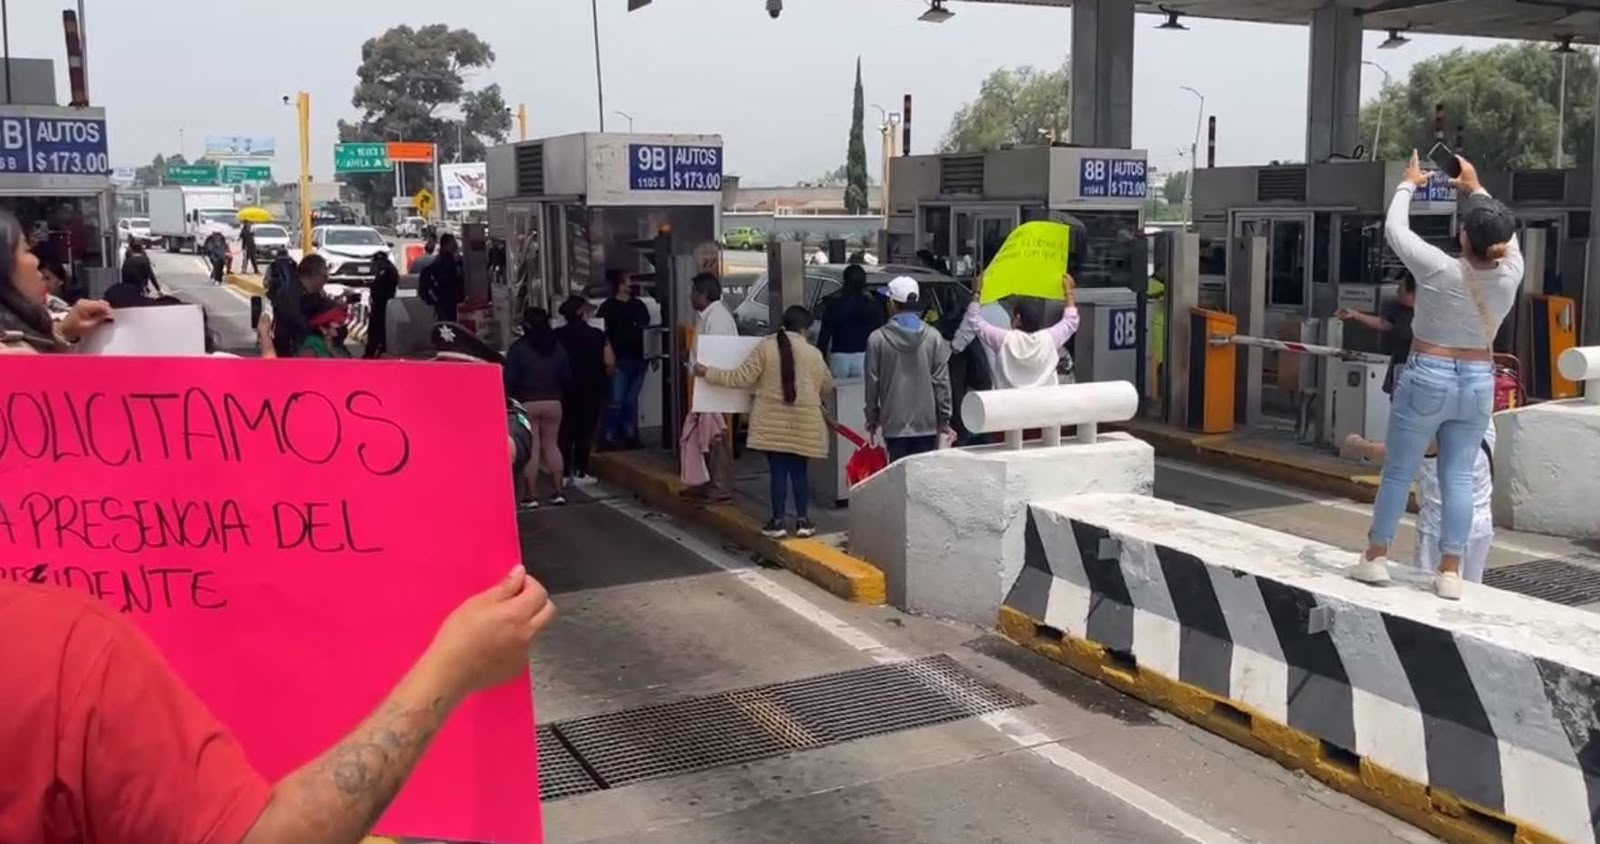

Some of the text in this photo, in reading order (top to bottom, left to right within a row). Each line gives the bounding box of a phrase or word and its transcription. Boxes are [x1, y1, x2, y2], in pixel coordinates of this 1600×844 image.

[36, 121, 100, 143] AUTOS
[638, 146, 666, 171] 9B
[675, 147, 717, 166] AUTOS
[1085, 160, 1105, 181] 8B
[1113, 161, 1145, 177] AUTOS
[1114, 311, 1137, 346] 8B
[0, 387, 410, 477] OLICITAMOS
[20, 491, 251, 554] PRESENCIA
[272, 499, 385, 554] DEL
